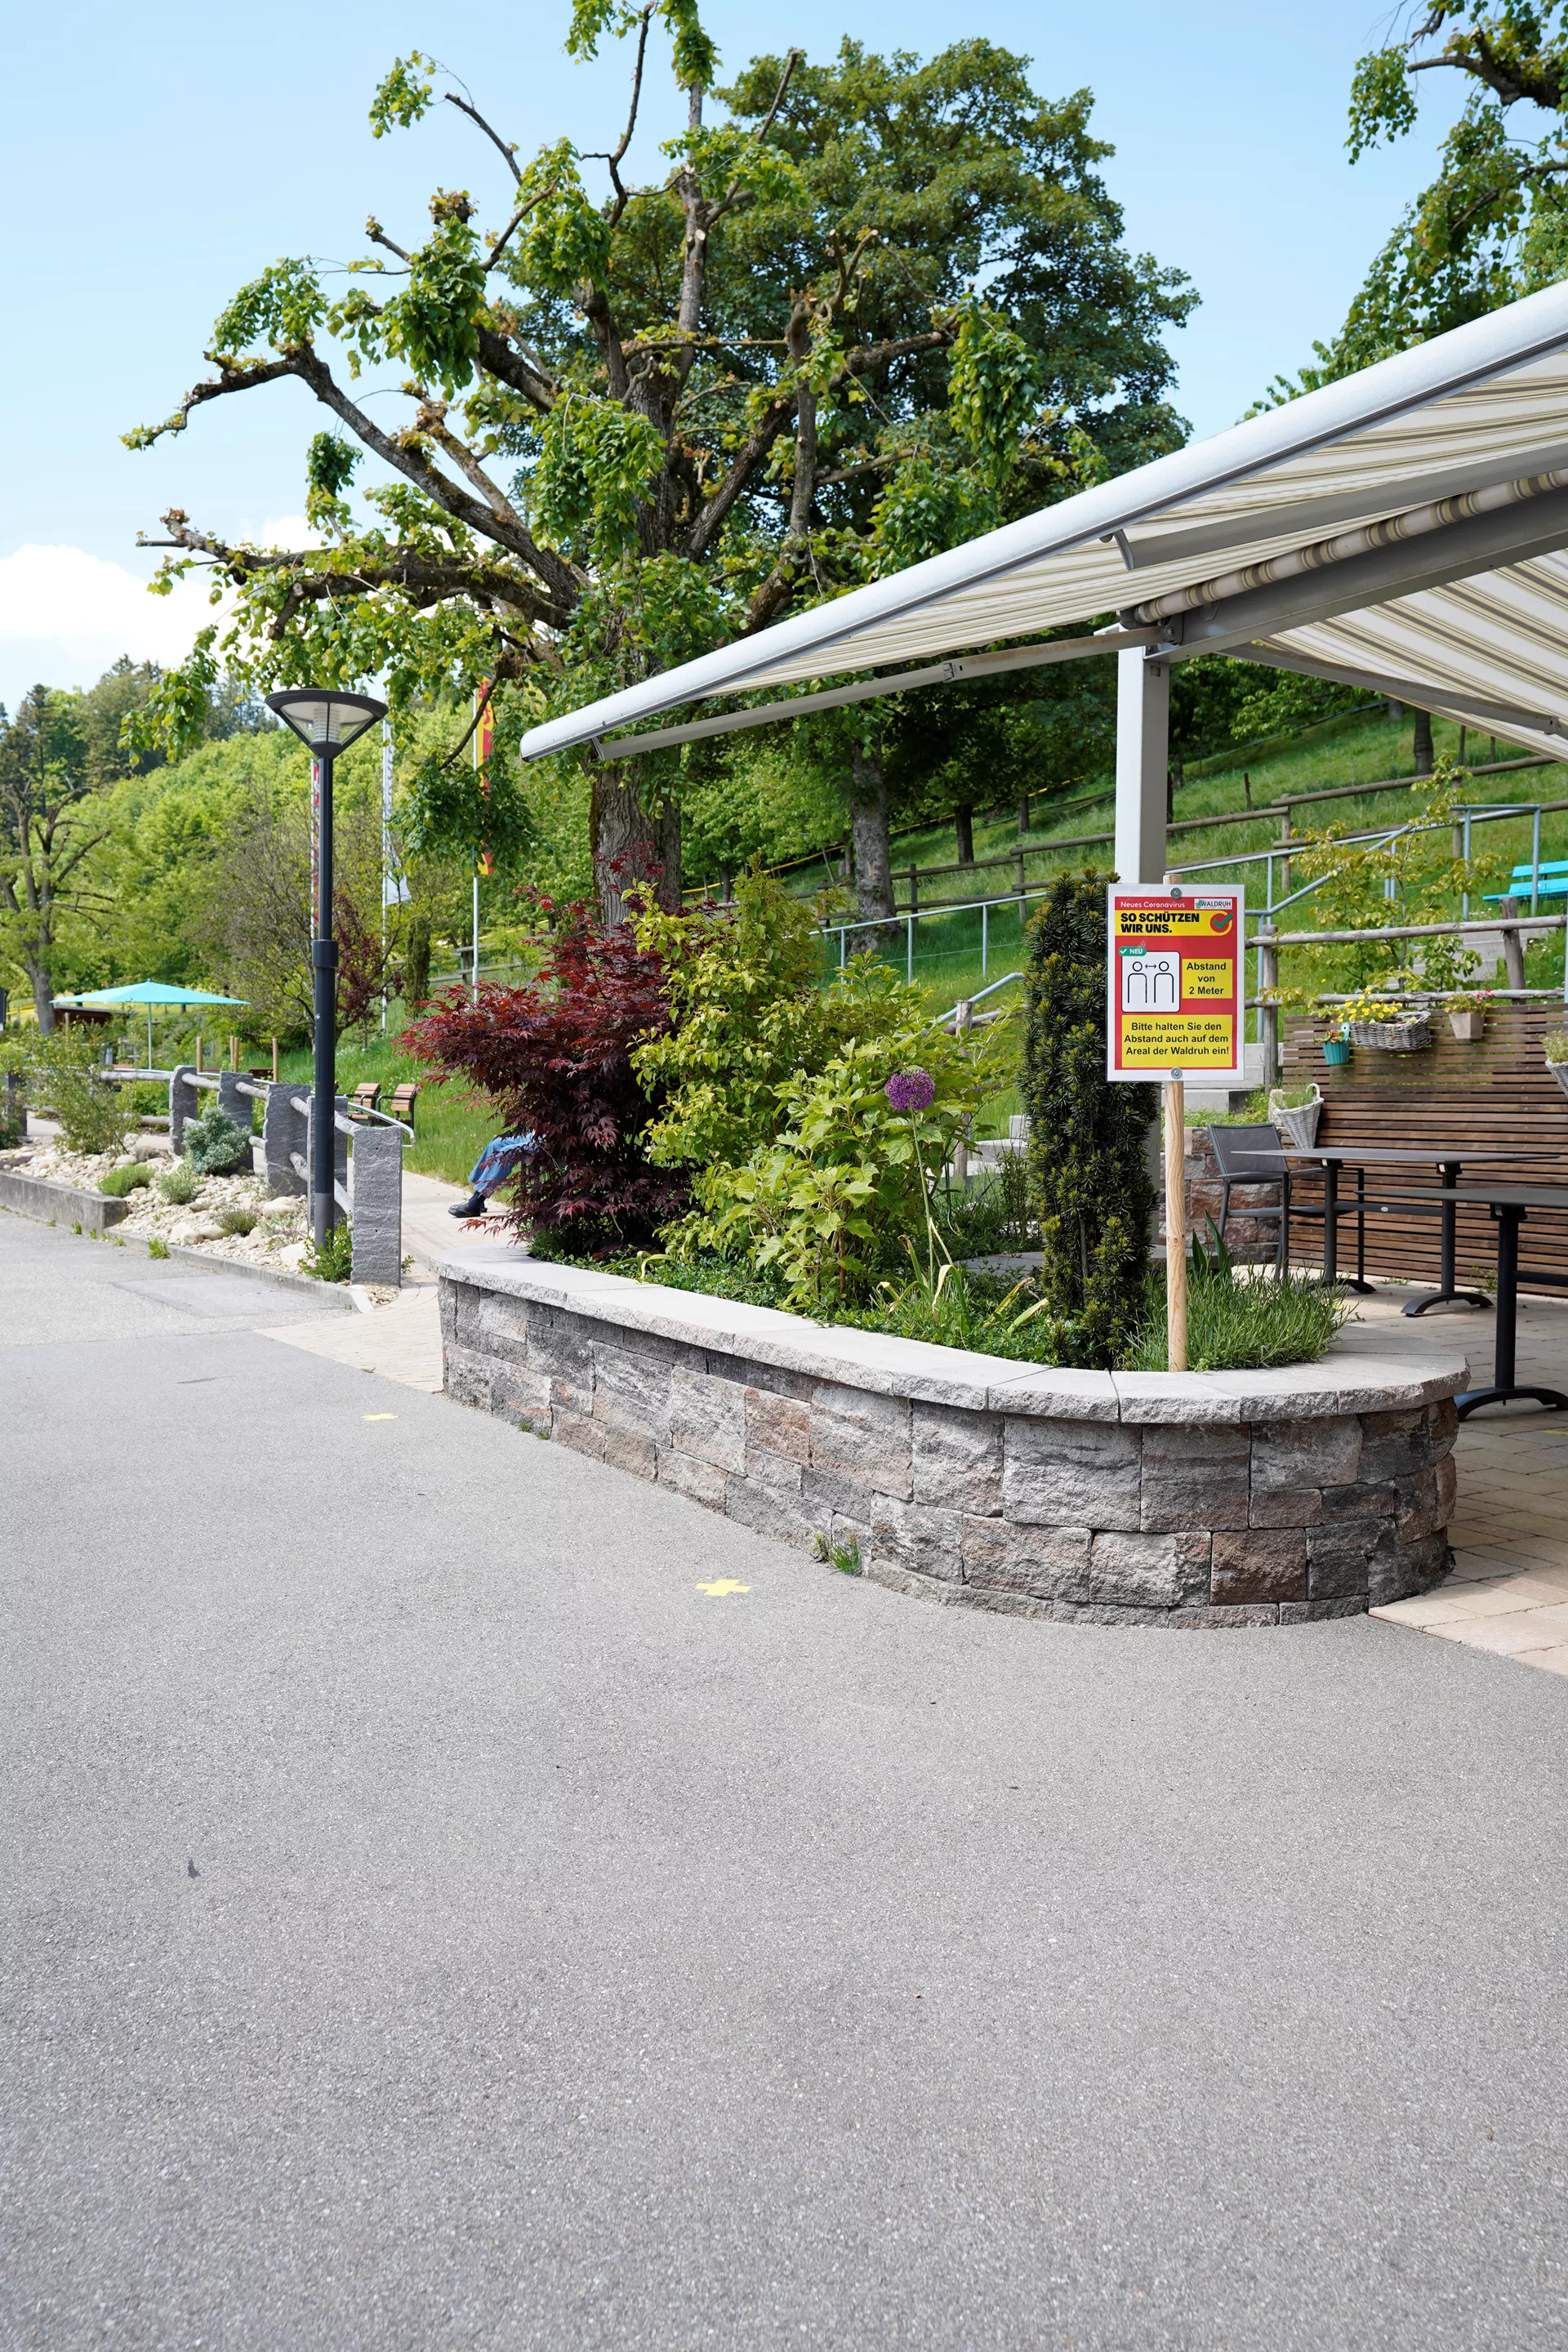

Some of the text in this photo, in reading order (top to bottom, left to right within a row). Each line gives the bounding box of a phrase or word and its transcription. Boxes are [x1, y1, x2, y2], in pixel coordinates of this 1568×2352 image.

[1120, 911, 1200, 922] SO SCHÜTZEN
[1120, 924, 1173, 933] WIR UNS.
[1187, 962, 1227, 970] Abstand
[1189, 986, 1224, 995] 2 Meter
[1131, 1022, 1222, 1031] Bitte halten Sie den
[1124, 1035, 1228, 1043] Abstand auch auf dem
[1125, 1047, 1229, 1055] Areal der Waldruh ein!
